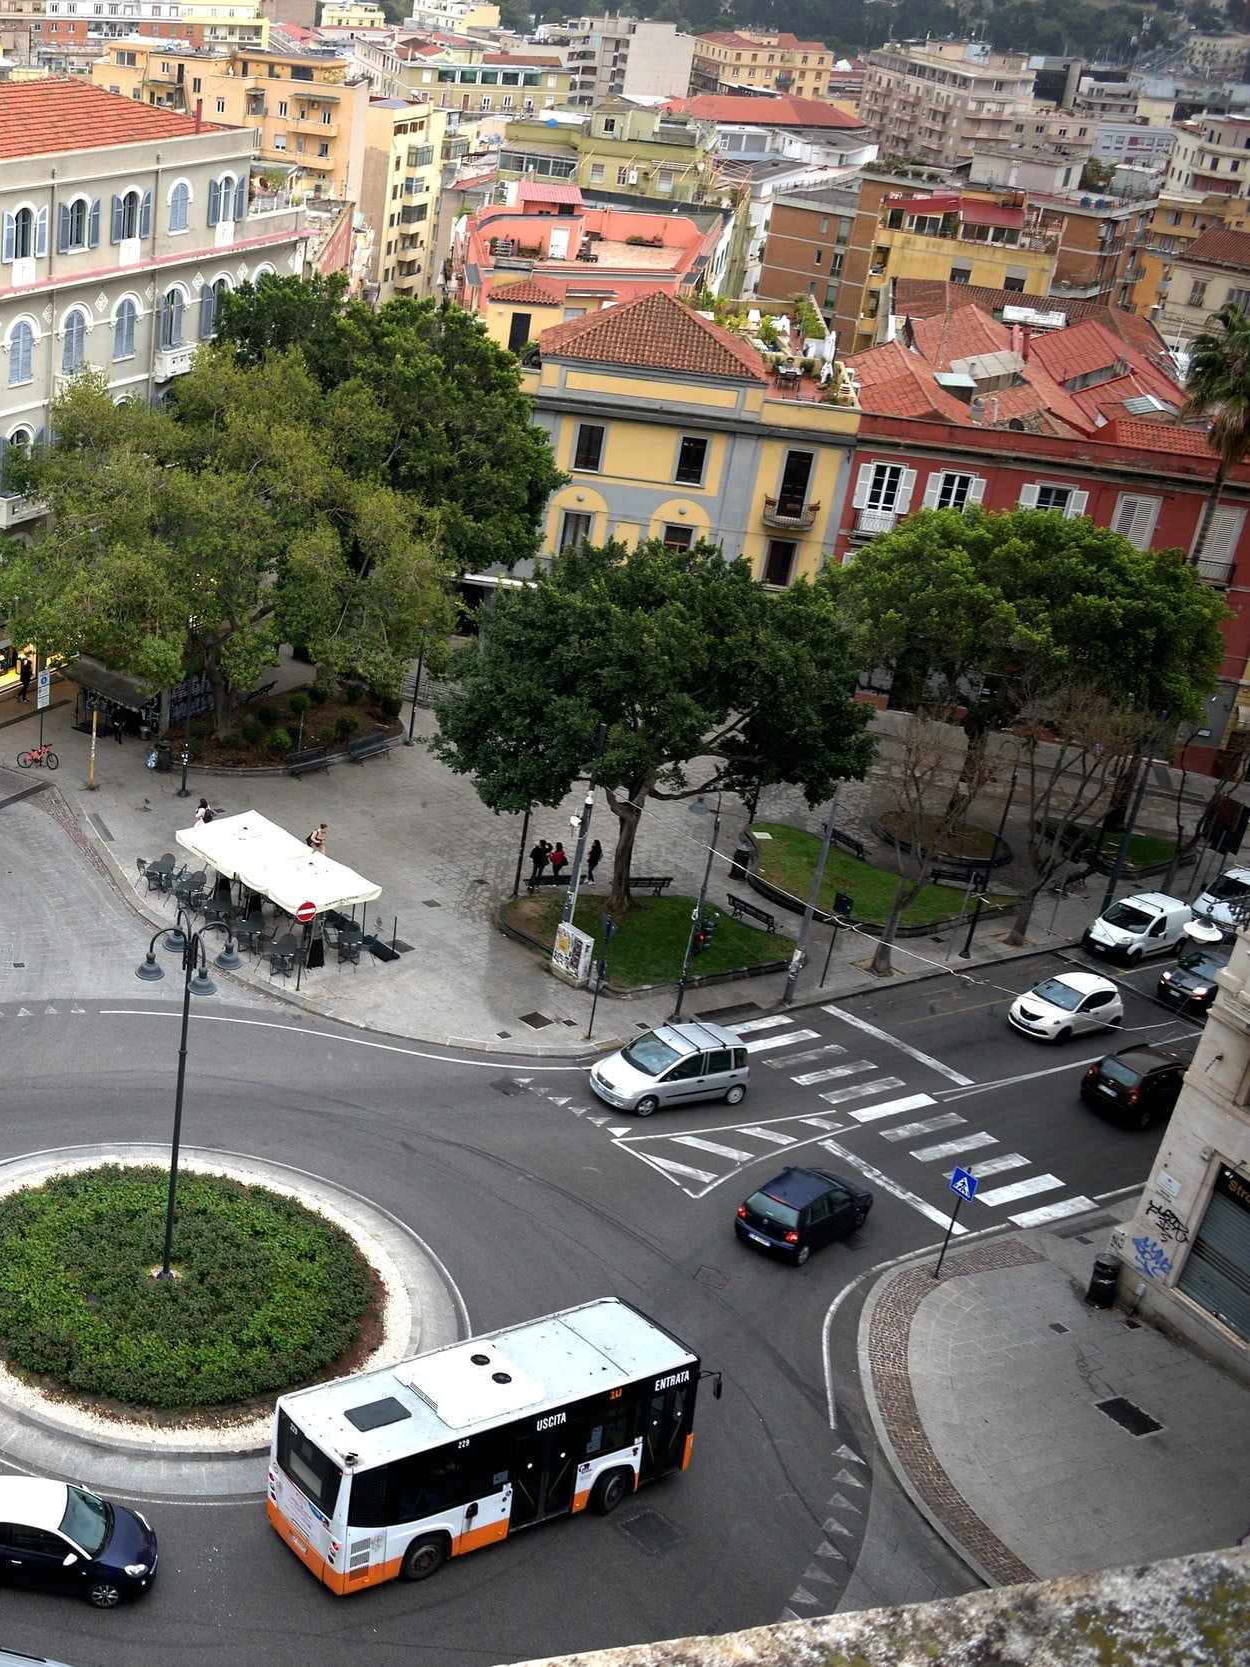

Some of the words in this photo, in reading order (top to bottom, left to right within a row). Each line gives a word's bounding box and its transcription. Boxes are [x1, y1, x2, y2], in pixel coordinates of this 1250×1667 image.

[654, 1370, 690, 1392] ENTRATA
[536, 1412, 567, 1432] USCITA
[457, 1438, 470, 1449] 229
